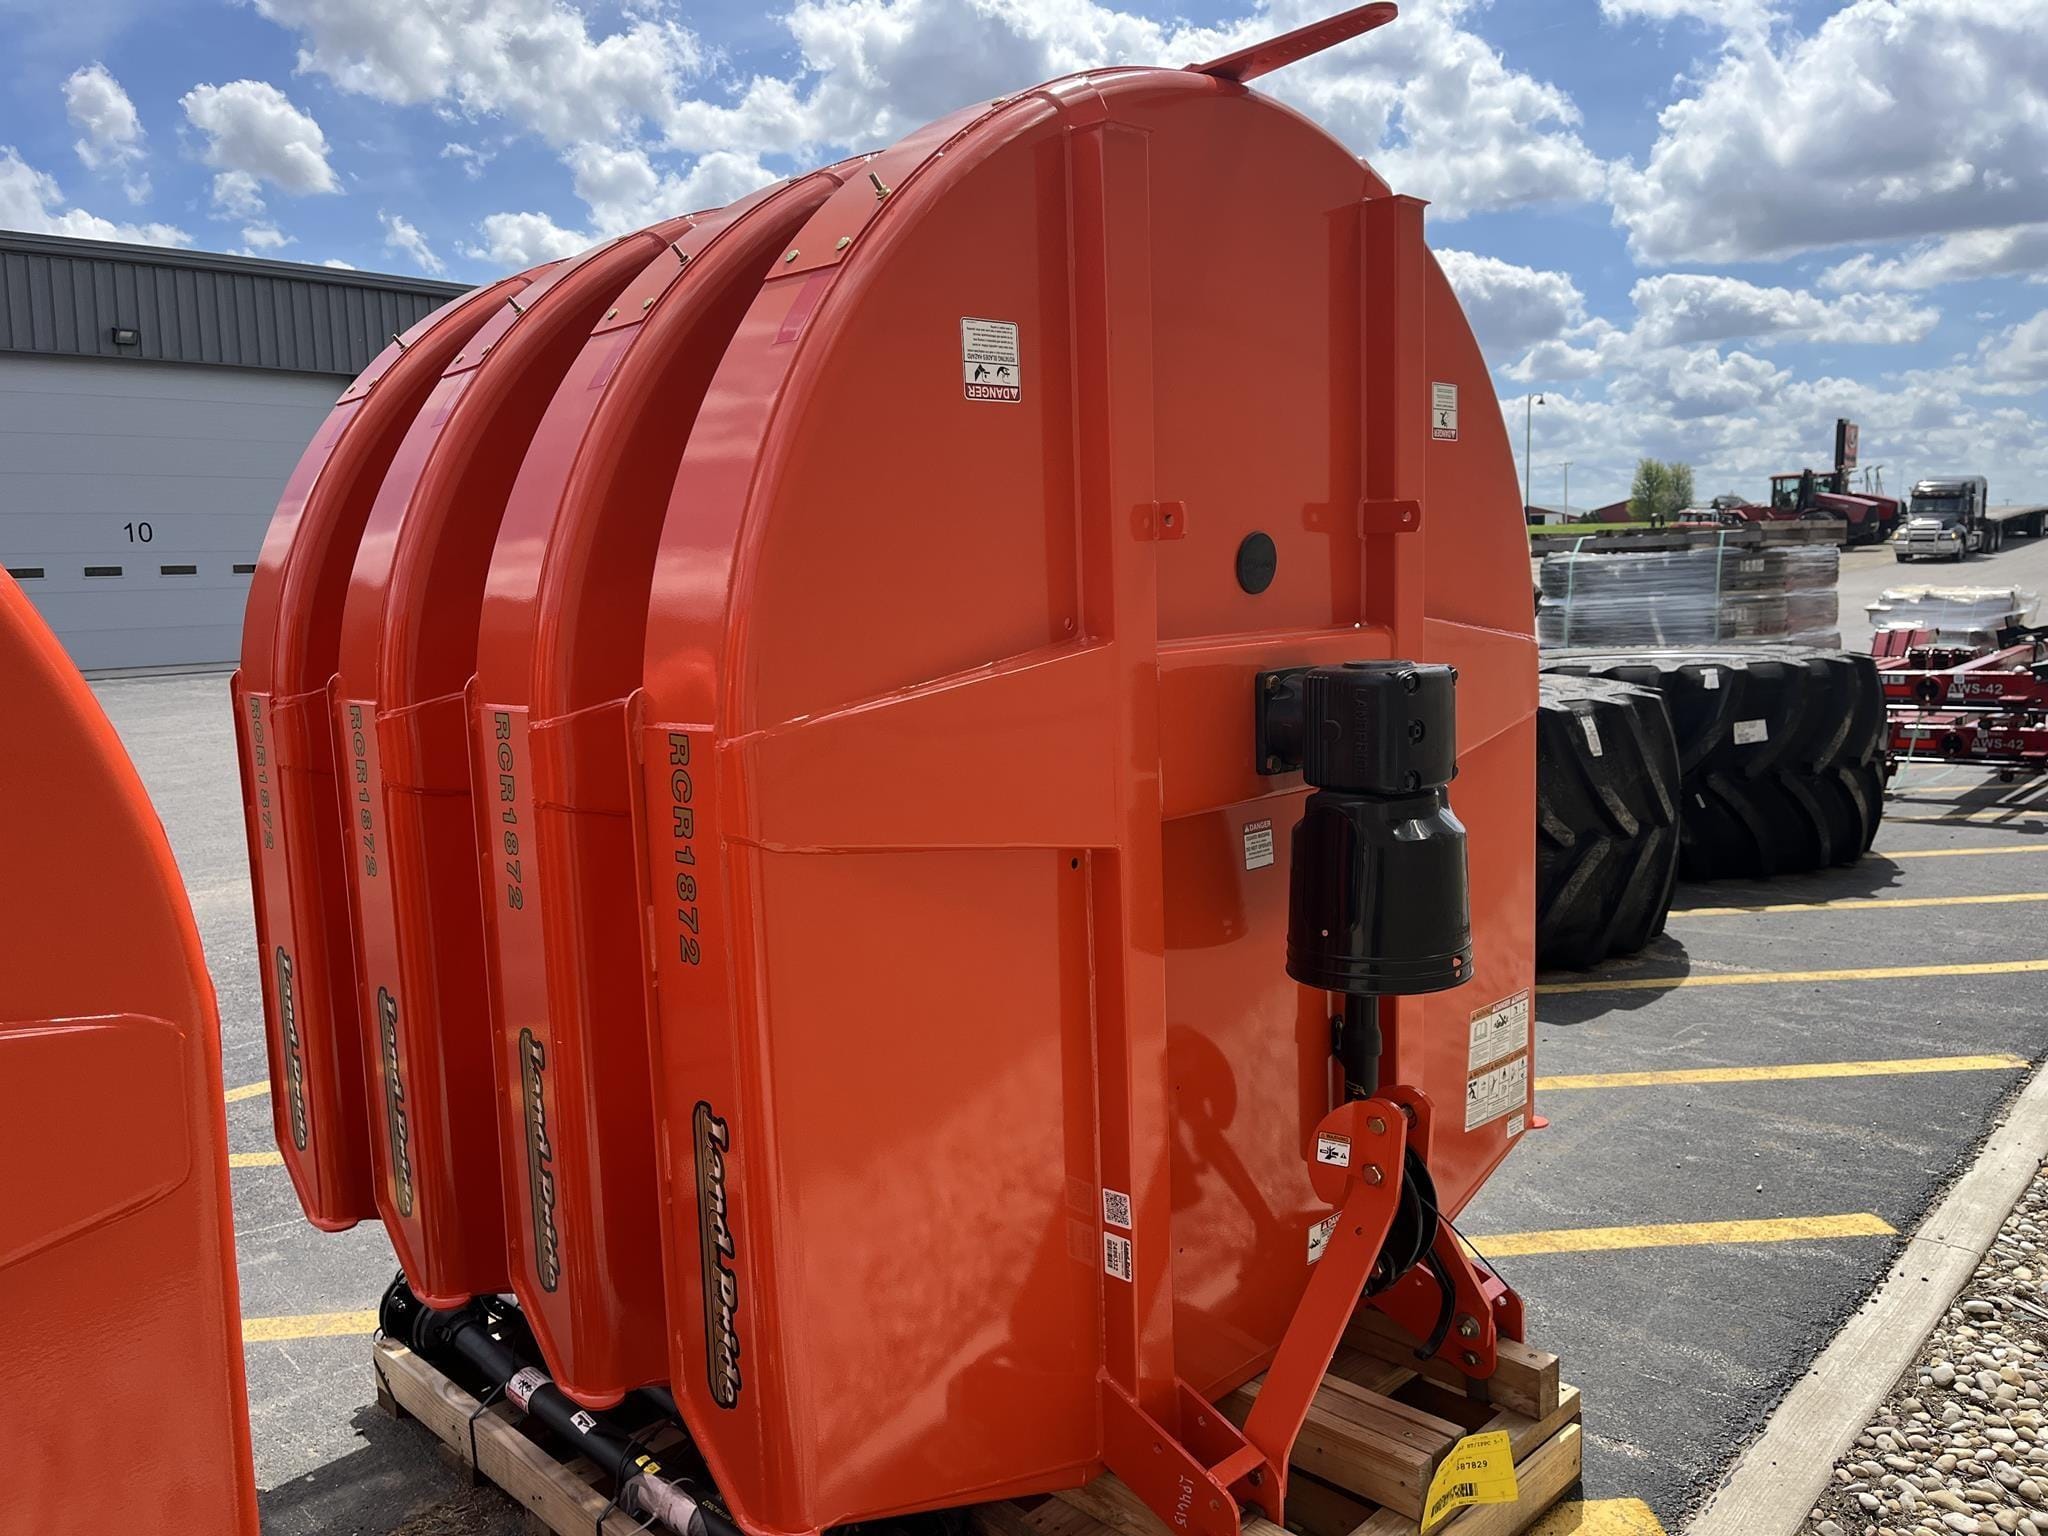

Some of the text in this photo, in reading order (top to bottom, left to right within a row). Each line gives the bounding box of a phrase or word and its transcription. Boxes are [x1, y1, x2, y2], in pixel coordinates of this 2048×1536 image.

[968, 386, 1010, 399] DANGER
[123, 522, 153, 543] 10
[250, 698, 274, 850] RCR1872
[1948, 683, 2004, 695] AWS-42
[1970, 738, 2025, 750] AWS-42
[349, 705, 377, 878] RCR1872
[494, 712, 523, 910] RCR1872
[668, 732, 701, 966] RCR1872
[1250, 820, 1271, 831] DANGER
[281, 953, 308, 1150] Land Pride
[381, 995, 414, 1217] Land Pride
[526, 1038, 561, 1292] Land Pride
[699, 1112, 742, 1409] Land Pride
